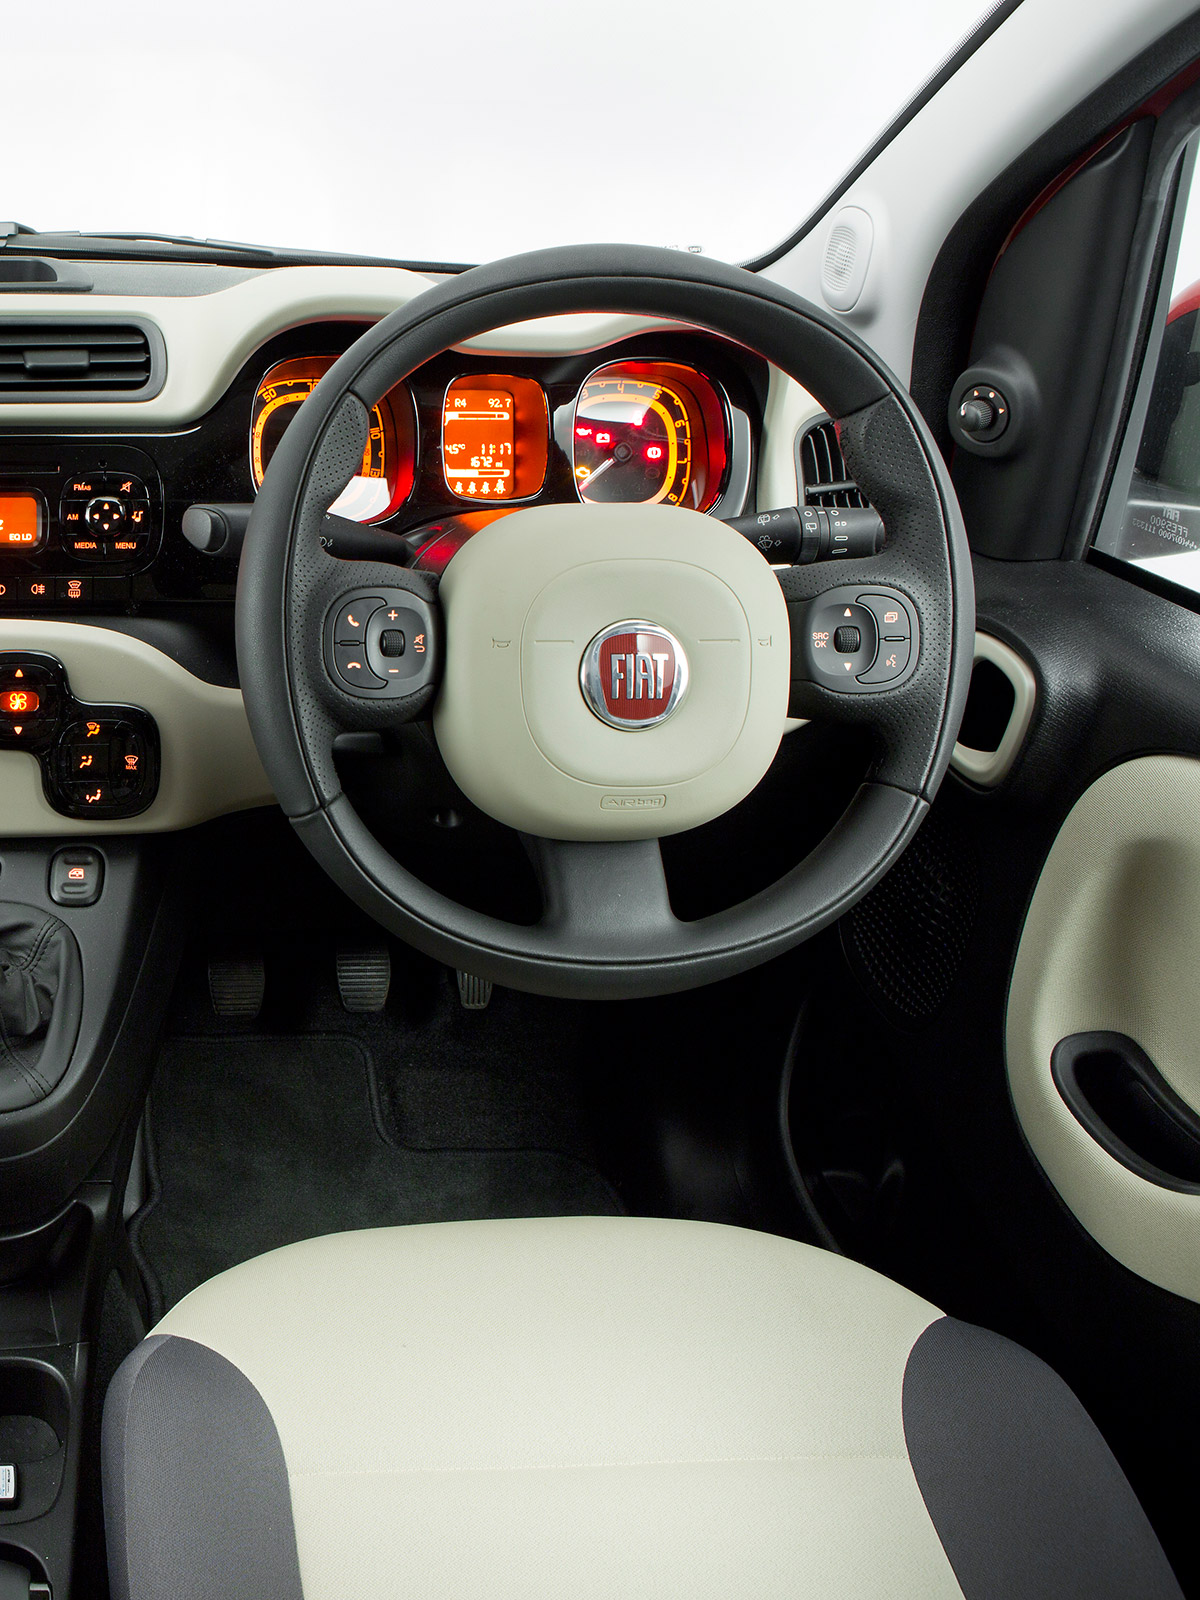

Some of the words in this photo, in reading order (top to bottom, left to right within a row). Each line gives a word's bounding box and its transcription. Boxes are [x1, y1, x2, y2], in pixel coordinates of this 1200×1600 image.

[582, 388, 589, 399] 3
[617, 383, 625, 394] 4
[262, 388, 277, 402] 50
[653, 389, 663, 400] 5
[454, 398, 467, 408] R4
[488, 398, 512, 408] 92.7
[675, 419, 685, 428] 6
[481, 443, 512, 455] 11:17
[667, 492, 678, 502] 8
[66, 513, 79, 521] AM
[9, 533, 21, 541] EQ
[812, 632, 830, 640] SRC
[814, 640, 827, 648] OK
[610, 653, 669, 700] FIAT
